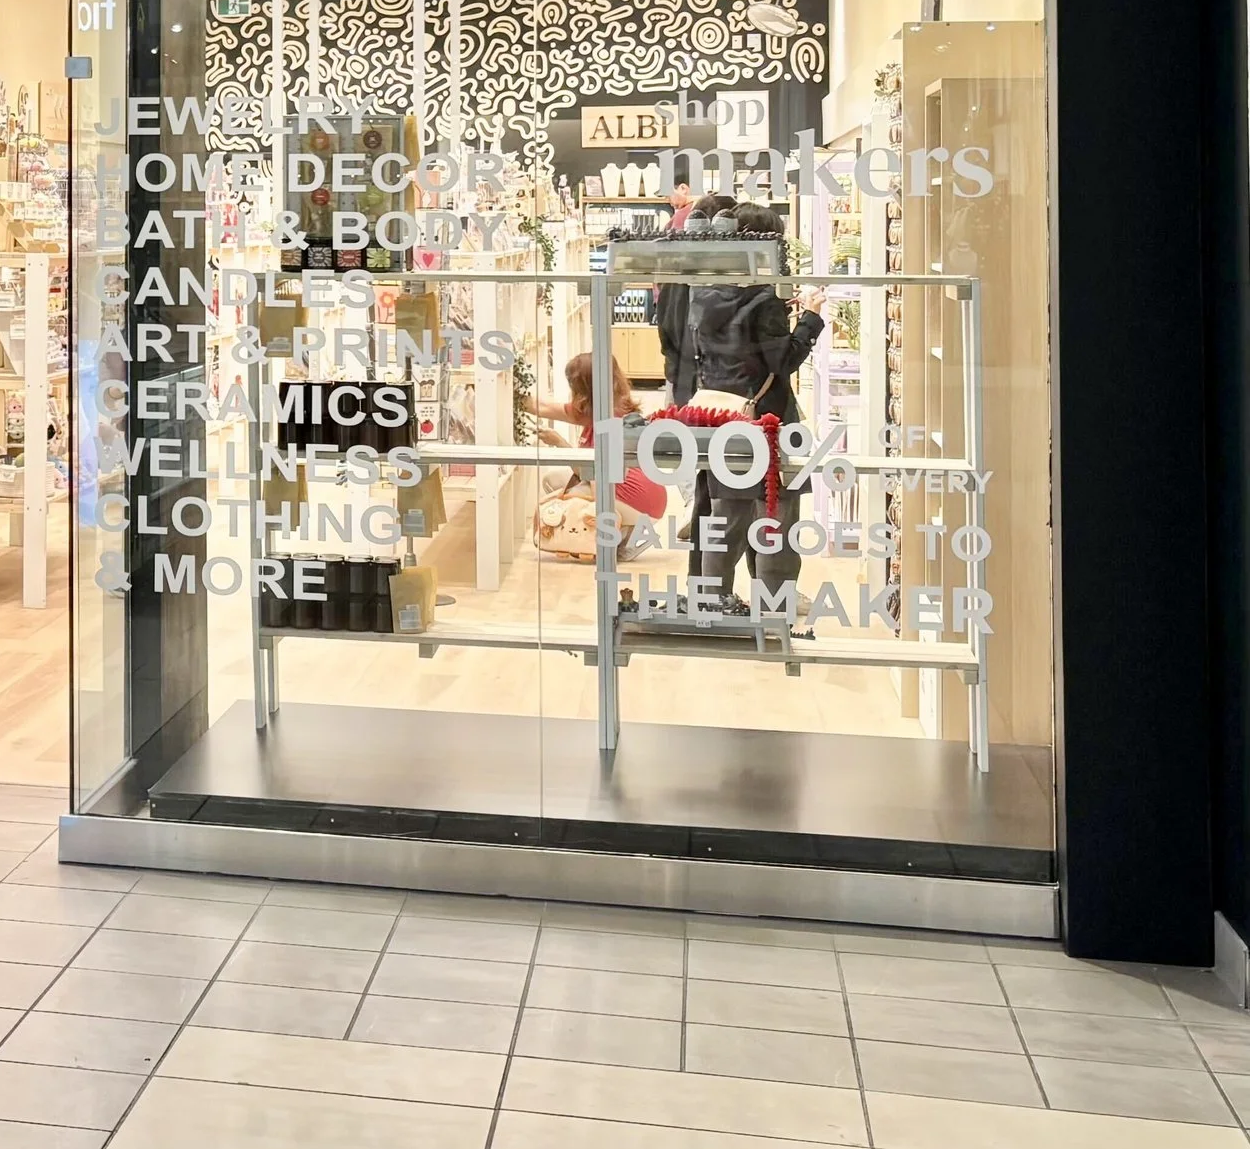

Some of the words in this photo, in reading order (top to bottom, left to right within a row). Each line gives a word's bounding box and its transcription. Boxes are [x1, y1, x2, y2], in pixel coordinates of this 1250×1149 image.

[95, 95, 376, 136] JEWELRY
[653, 90, 765, 136] shop
[96, 153, 264, 193] HOME
[288, 152, 506, 193] DECOR
[654, 128, 994, 198] makers
[96, 209, 246, 250] BATH
[271, 210, 310, 252] &
[332, 210, 508, 252] BODY
[95, 266, 376, 309] CANDLES
[93, 323, 210, 365] ART
[232, 325, 269, 366] &
[293, 328, 516, 370] PRINTS
[95, 378, 408, 428] CERAMICS
[594, 417, 857, 492] 100%
[878, 425, 926, 449] OF
[95, 436, 423, 488] WELLNESS
[879, 467, 994, 494] EVERY
[96, 493, 402, 545] CLOTHING
[595, 511, 728, 552] SALE
[747, 517, 896, 559] GOES
[915, 523, 992, 562] TO
[95, 550, 132, 591] &
[154, 553, 328, 602] MORE
[594, 571, 723, 621] THE
[750, 578, 994, 634] MAKER
